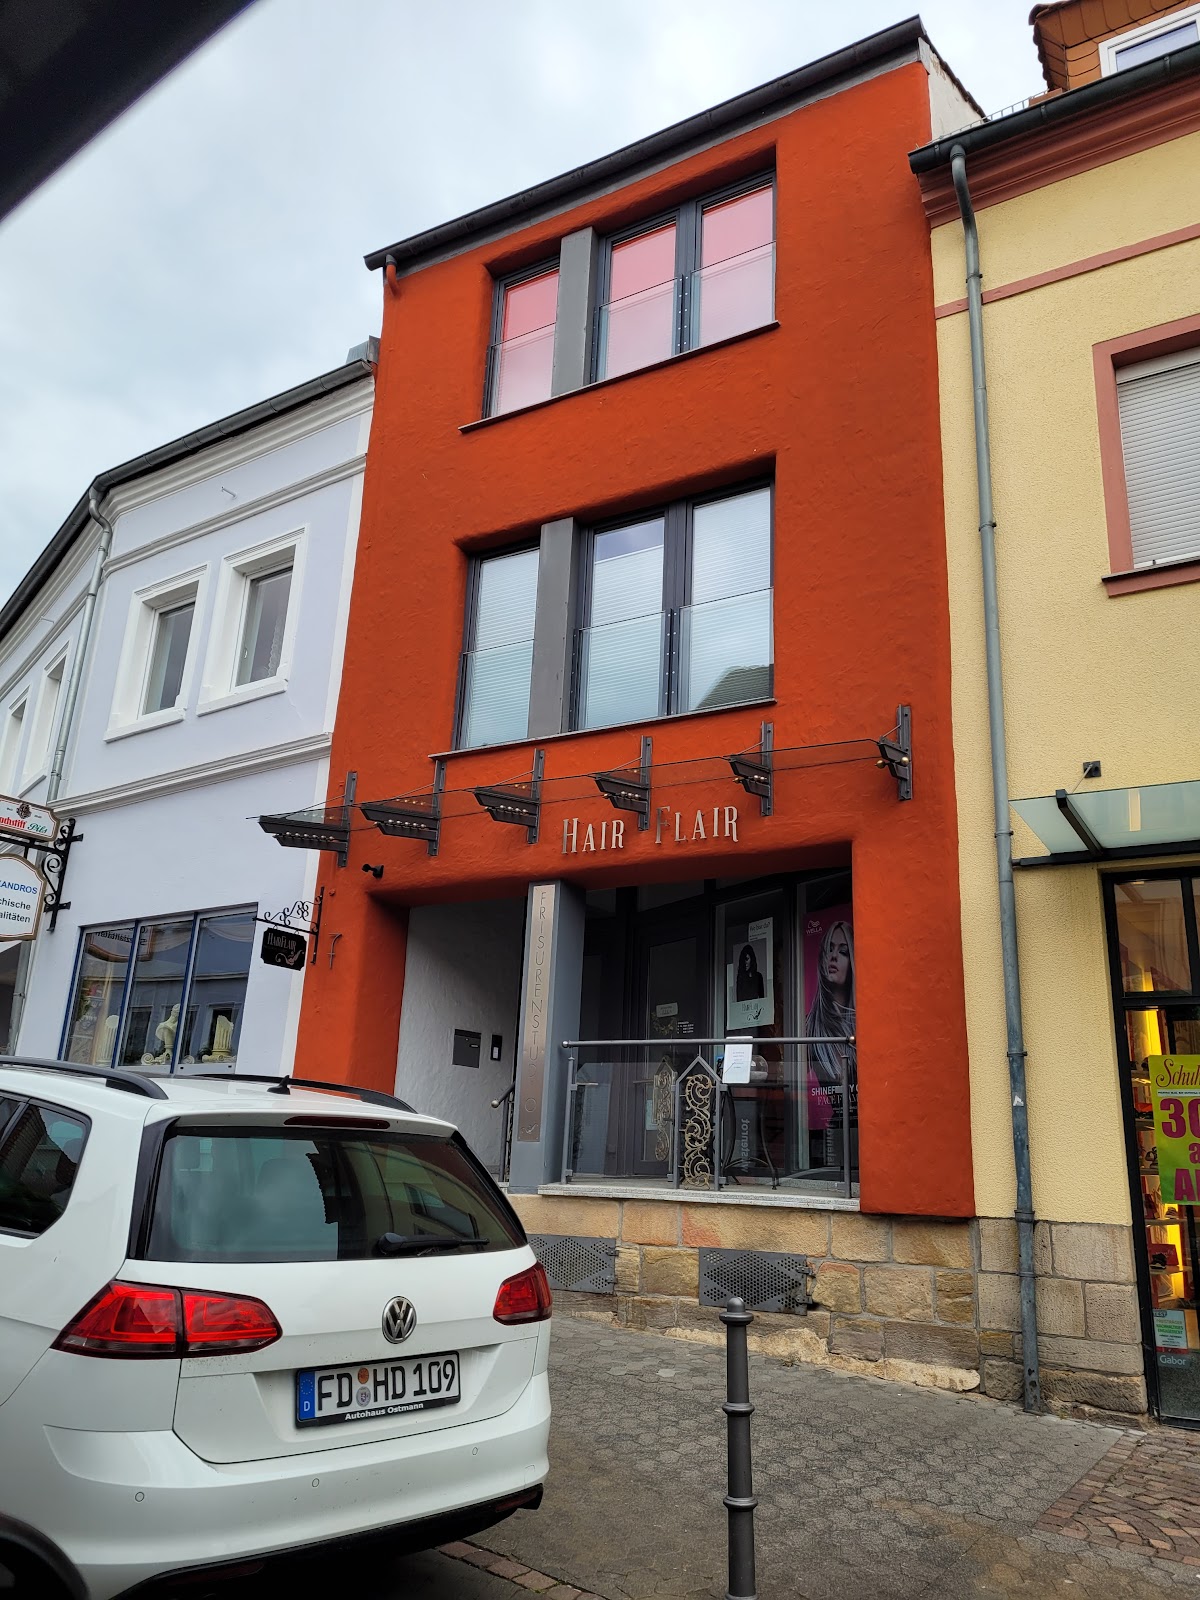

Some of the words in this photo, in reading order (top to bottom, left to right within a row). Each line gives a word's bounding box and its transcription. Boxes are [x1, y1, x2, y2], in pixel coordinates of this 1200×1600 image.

[561, 817, 625, 854] HAIR
[654, 805, 739, 843] FLAIR
[1159, 1354, 1187, 1366] Gabor
[317, 1372, 353, 1411] FD
[373, 1365, 406, 1402] HD
[413, 1359, 456, 1397] 109
[303, 1400, 311, 1412] D
[344, 1409, 386, 1421] Autohaus
[387, 1402, 424, 1415] Ostmann
